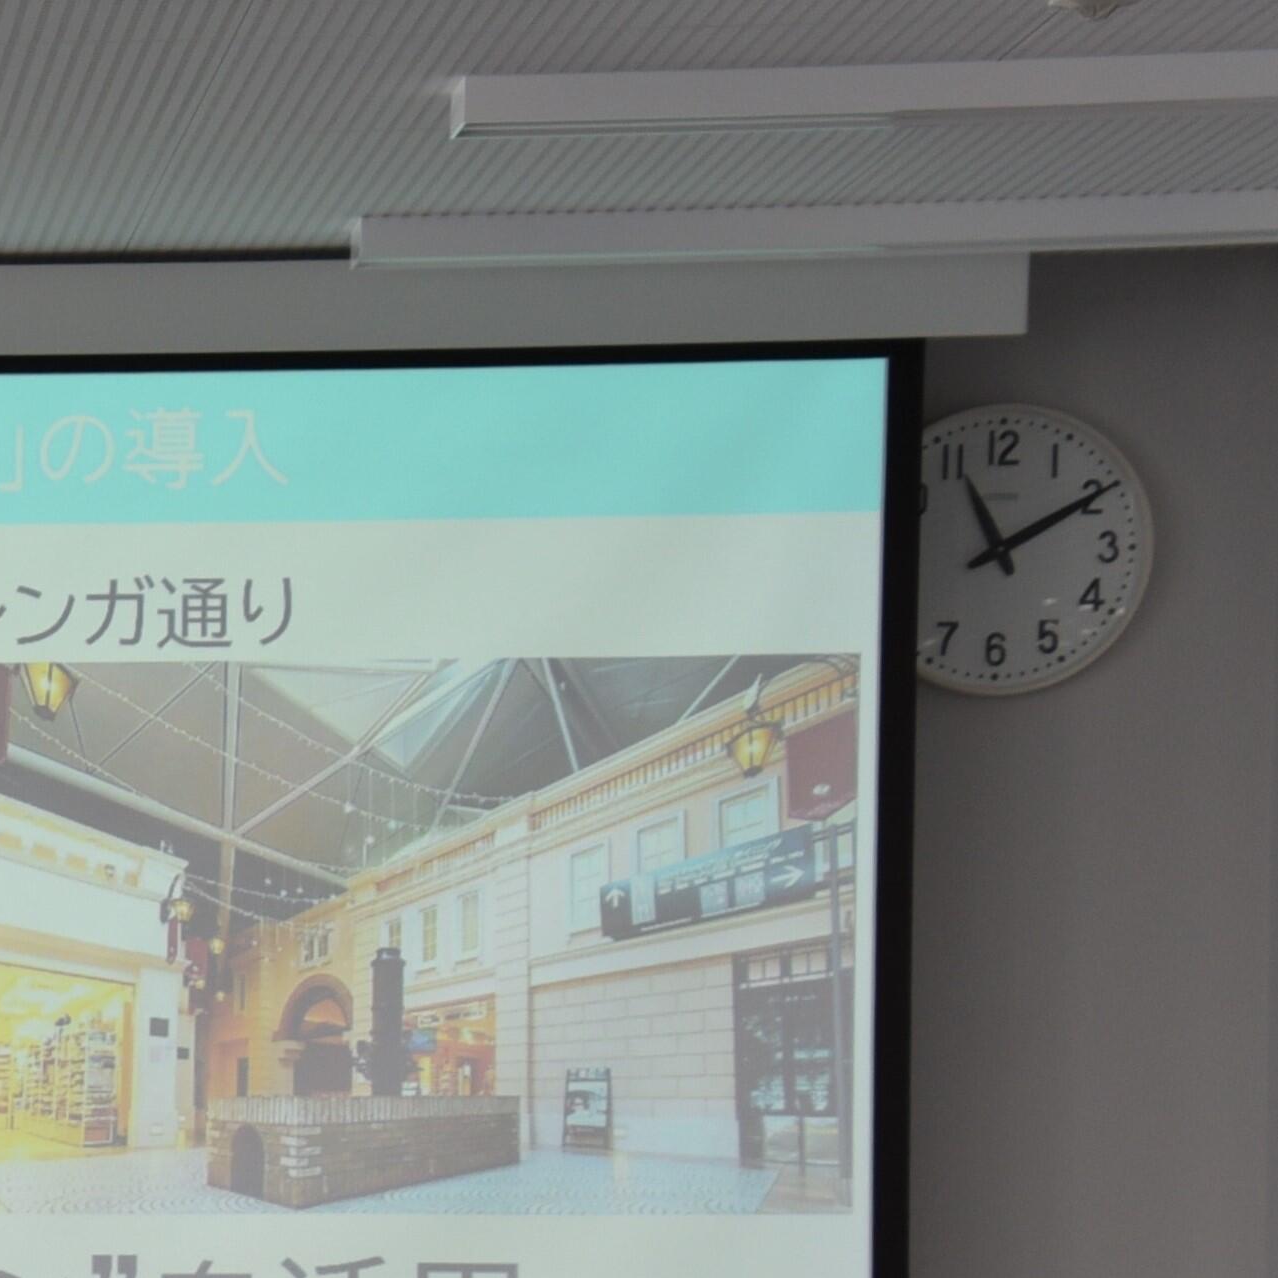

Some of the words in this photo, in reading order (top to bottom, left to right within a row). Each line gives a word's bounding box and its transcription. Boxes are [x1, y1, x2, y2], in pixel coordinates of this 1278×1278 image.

[942, 443, 964, 480] 11
[988, 429, 1021, 466] 12
[1050, 443, 1059, 479] 1
[1080, 479, 1104, 515] 2
[1097, 530, 1120, 564] 3
[1077, 577, 1106, 612] 4
[936, 621, 960, 656] 7
[984, 632, 1007, 667] 6
[1037, 618, 1060, 654] 5
